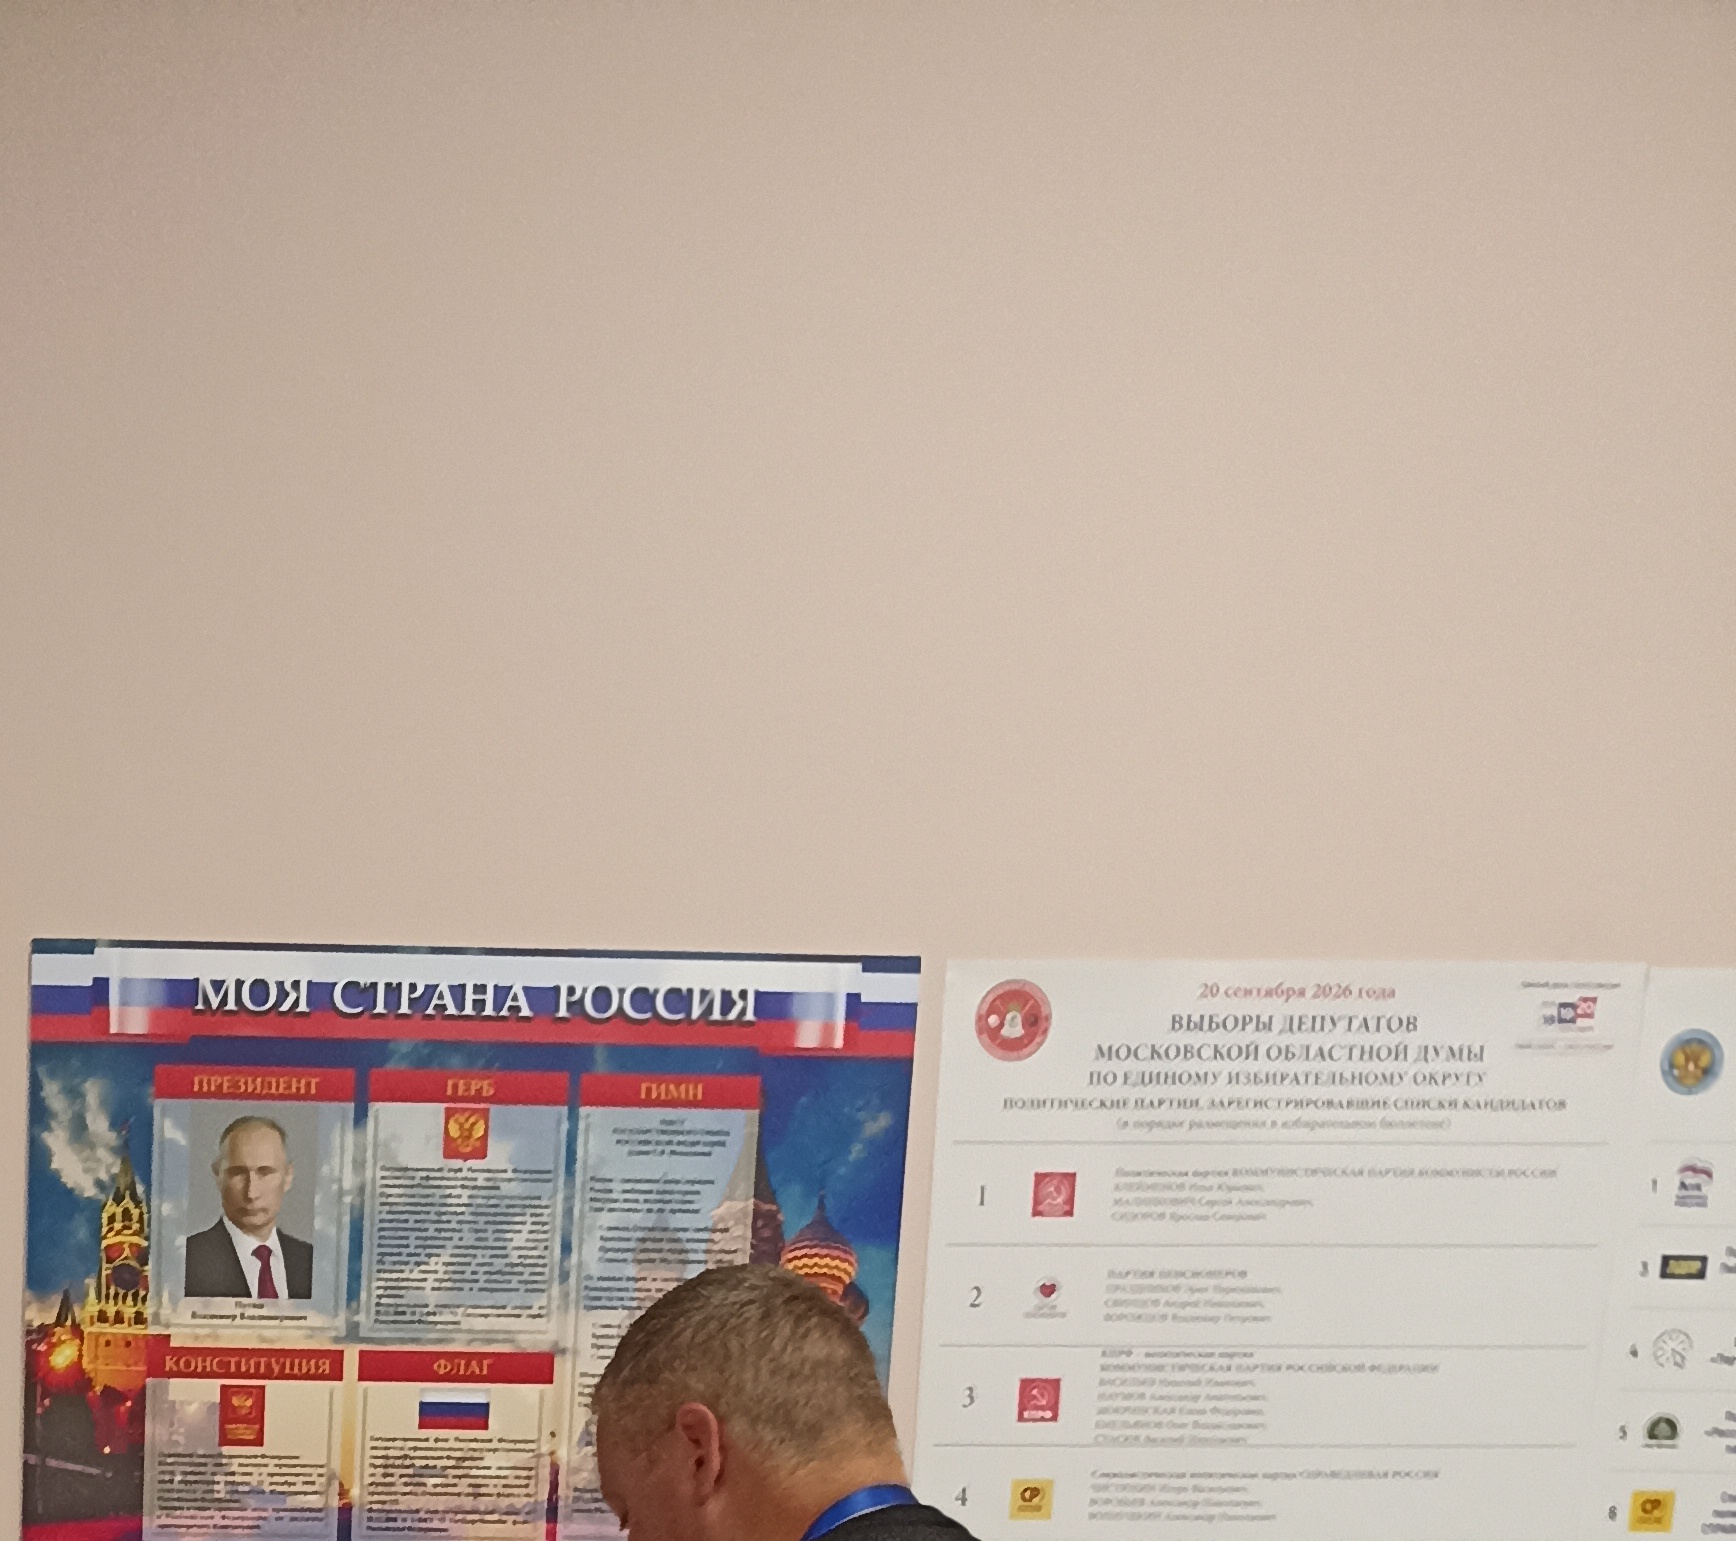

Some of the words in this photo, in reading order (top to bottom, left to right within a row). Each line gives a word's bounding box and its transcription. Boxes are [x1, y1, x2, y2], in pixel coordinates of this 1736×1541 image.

[194, 977, 310, 1014] МОЯ
[333, 978, 531, 1018] СТРАНА
[555, 981, 759, 1022] РОССИЯ
[1198, 982, 1220, 999] 20
[1223, 981, 1306, 1003] сентября
[1311, 982, 1353, 1000] 2026
[1358, 986, 1396, 1000] года
[1170, 1013, 1273, 1033] ВЫБОРЫ
[1277, 1014, 1418, 1035] ДЕПУТАТОВ
[1094, 1040, 1259, 1061] МОСКОВСКОЙ
[1265, 1041, 1408, 1062] ОБЛАСТНОЙ
[1413, 1044, 1485, 1063] ДУМЫ
[194, 1074, 321, 1096] ПРЕЗИДЕНТ
[447, 1079, 495, 1098] ГЕРБ
[1087, 1070, 1117, 1086] ПО
[1123, 1070, 1223, 1087] ЕДИНОМУ
[1227, 1070, 1408, 1088] ИЗБИРАТЕЛЬНОМУ
[1413, 1071, 1488, 1087] ОКРУГУ
[640, 1082, 704, 1101] ГИМН
[978, 1185, 986, 1206] 1
[969, 1285, 984, 1308] 2
[164, 1354, 331, 1377] КОНСТИТУЦИЯ
[433, 1358, 494, 1376] ФЛАГ
[961, 1385, 975, 1408] 3
[954, 1485, 968, 1507] 4
